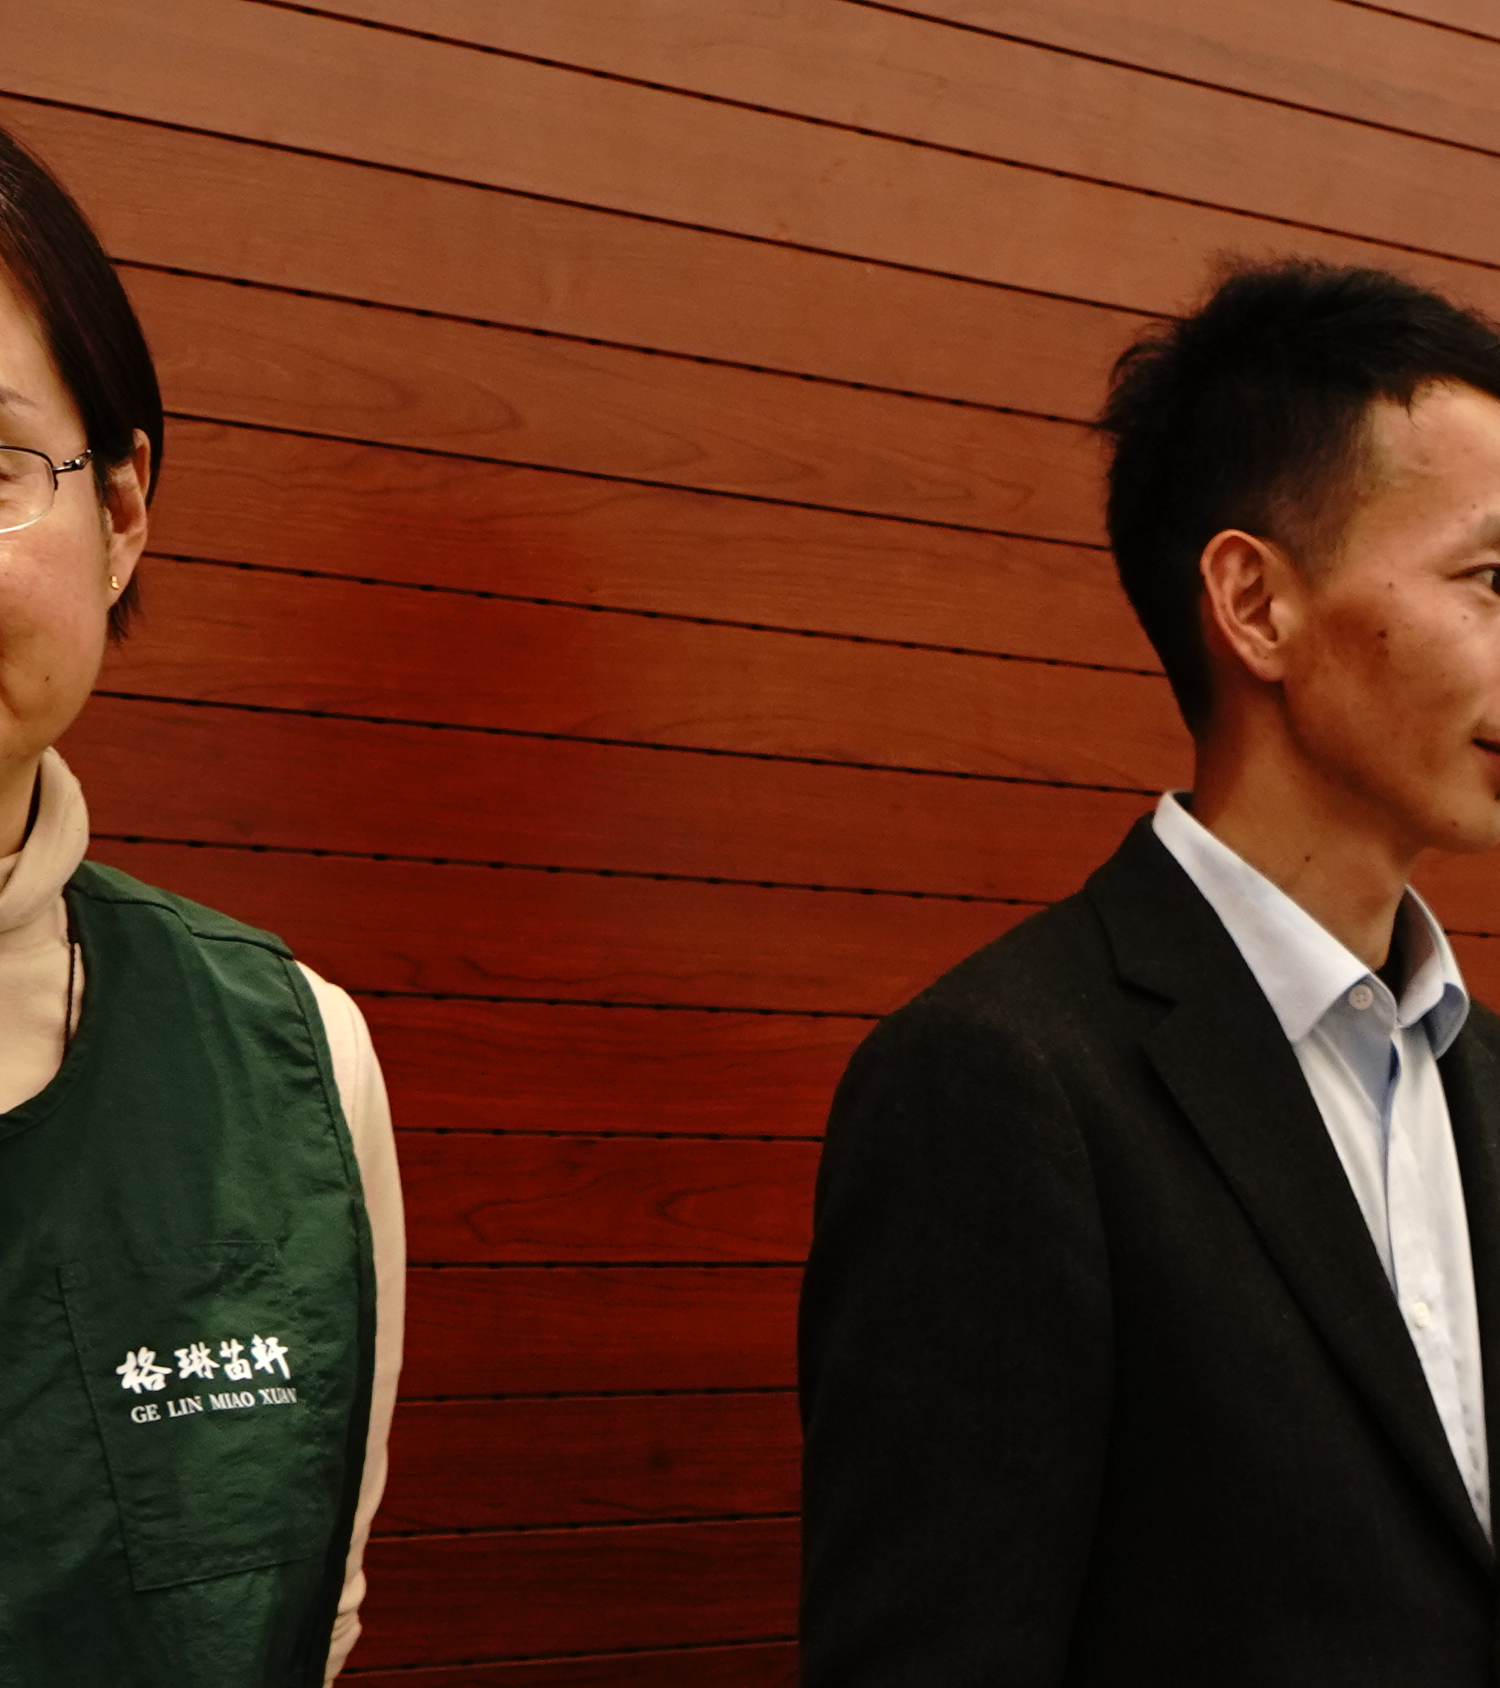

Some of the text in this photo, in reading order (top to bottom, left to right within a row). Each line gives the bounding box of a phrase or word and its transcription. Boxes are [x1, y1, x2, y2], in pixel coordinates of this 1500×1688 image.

[115, 1333, 292, 1394] 格琳苗轩
[130, 1387, 298, 1424] GE LIN MIAO XUAN
